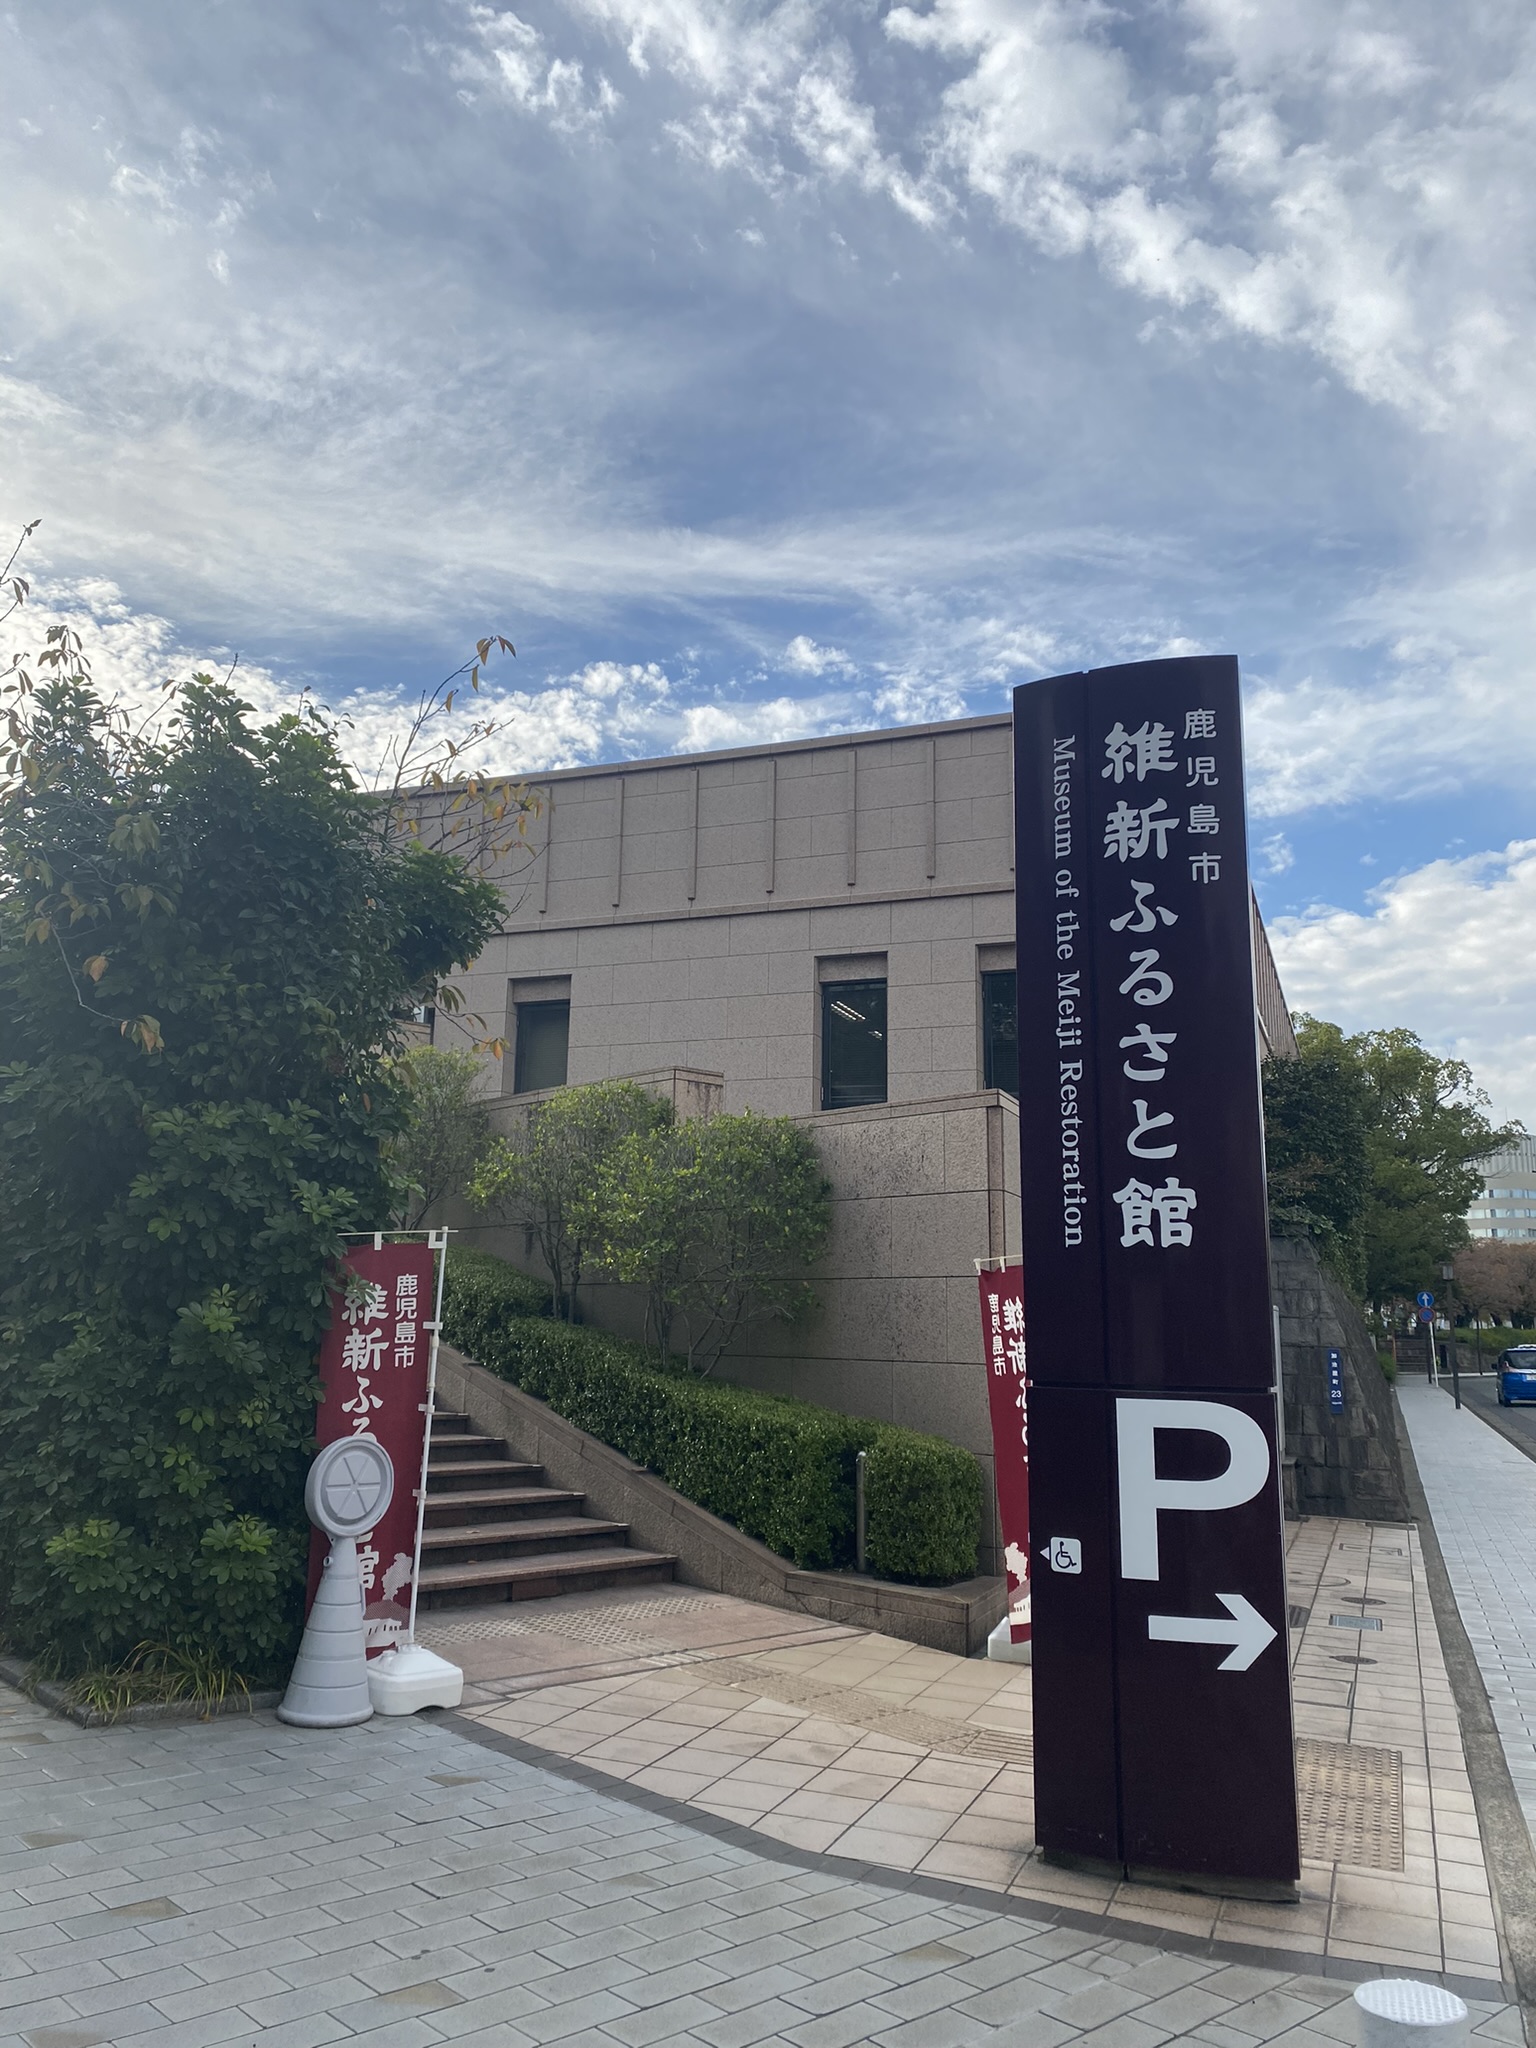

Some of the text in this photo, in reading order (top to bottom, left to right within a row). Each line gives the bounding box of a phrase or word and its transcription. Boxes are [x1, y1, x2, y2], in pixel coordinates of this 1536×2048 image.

[1184, 708, 1221, 884] 鹿児島市
[1053, 735, 1087, 1248] Museum of the Meiji Restoration
[1101, 720, 1197, 1249] 維新ふるさと館
[394, 1273, 418, 1369] 鹿児島市
[1331, 1389, 1342, 1398] 23
[1115, 1397, 1270, 1582] P
